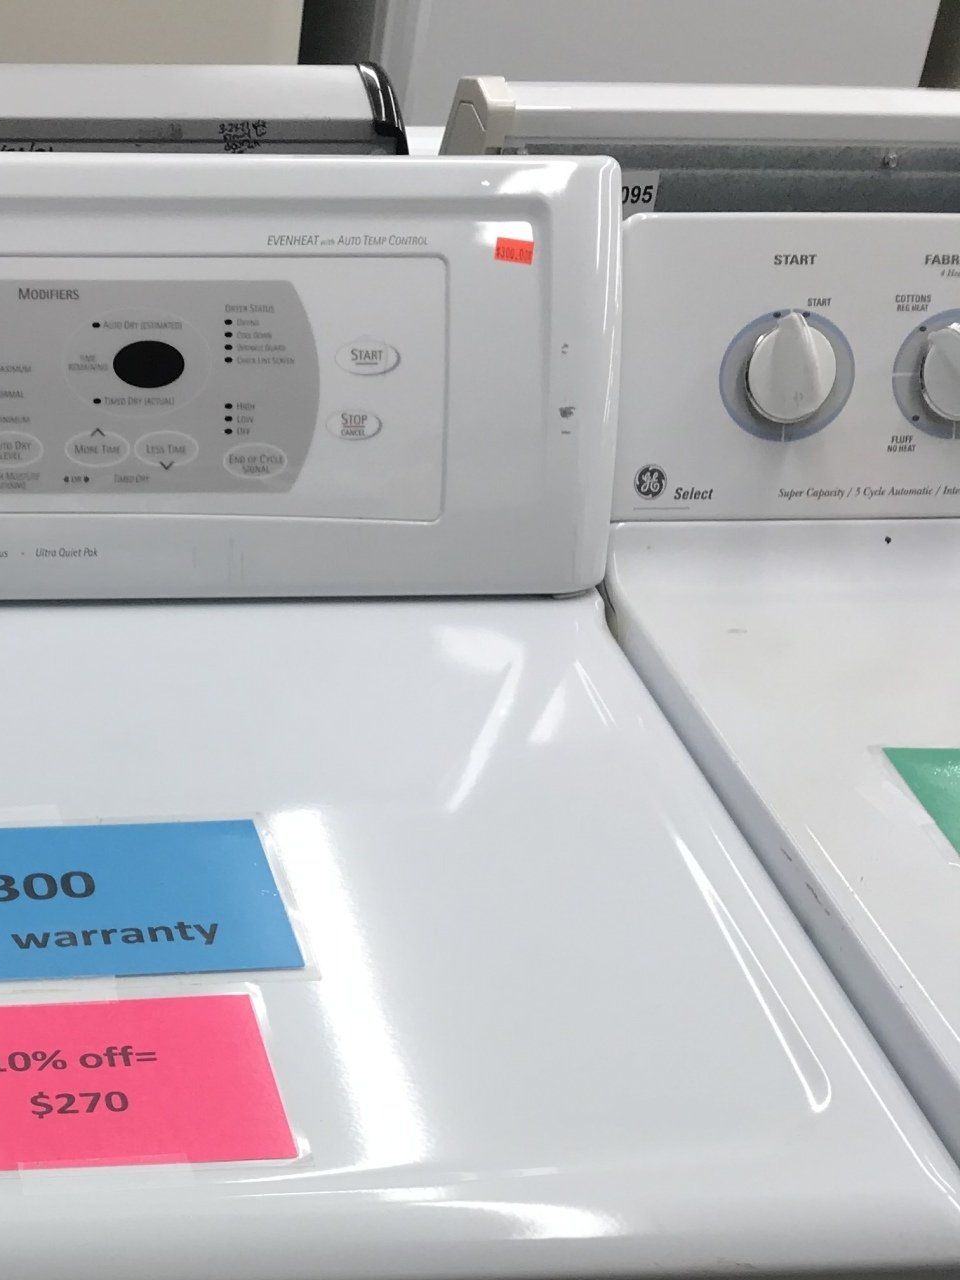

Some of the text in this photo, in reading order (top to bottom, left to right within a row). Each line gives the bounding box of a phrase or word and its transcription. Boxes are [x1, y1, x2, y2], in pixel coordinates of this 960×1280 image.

[267, 235, 319, 246] EVENHEAT
[337, 235, 361, 246] AUTO
[363, 235, 387, 246] TEMP
[389, 235, 428, 246] CONTROL
[773, 254, 817, 267] START
[18, 288, 80, 300] MODIFIERS
[895, 294, 932, 303] COTTONS
[807, 298, 832, 307] START
[351, 348, 383, 361] START
[341, 412, 368, 426] STOP
[341, 428, 365, 437] CANCEL
[891, 435, 913, 443] FLUFF
[674, 487, 714, 500] Select
[778, 487, 803, 500] Super
[806, 487, 845, 500] Capacity
[863, 485, 886, 500] Cycle
[889, 485, 933, 496] Automatic
[35, 548, 57, 558] Ultra
[58, 548, 81, 559] Quiet
[11, 919, 220, 951] warranty
[78, 1045, 158, 1069] off=
[29, 1090, 130, 1119] $270
